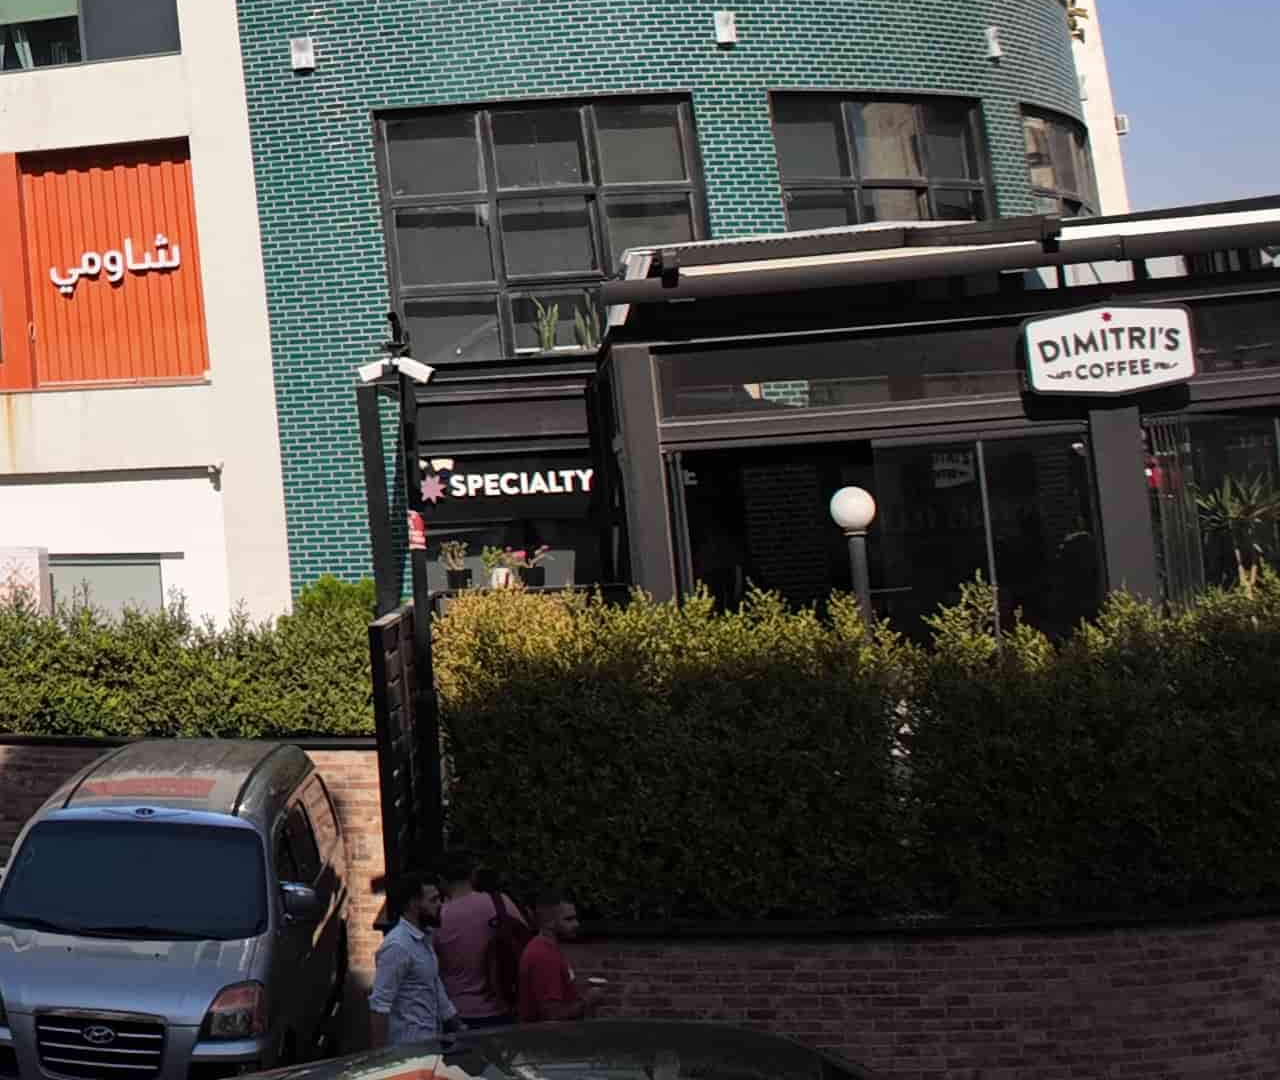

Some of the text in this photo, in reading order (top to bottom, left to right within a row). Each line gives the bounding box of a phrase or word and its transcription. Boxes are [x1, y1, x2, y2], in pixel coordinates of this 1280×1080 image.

[49, 233, 181, 295] شاومي
[1037, 326, 1181, 363] DIMITRI'S
[1075, 359, 1152, 380] COFFEE
[449, 469, 594, 497] SPECIALTY
